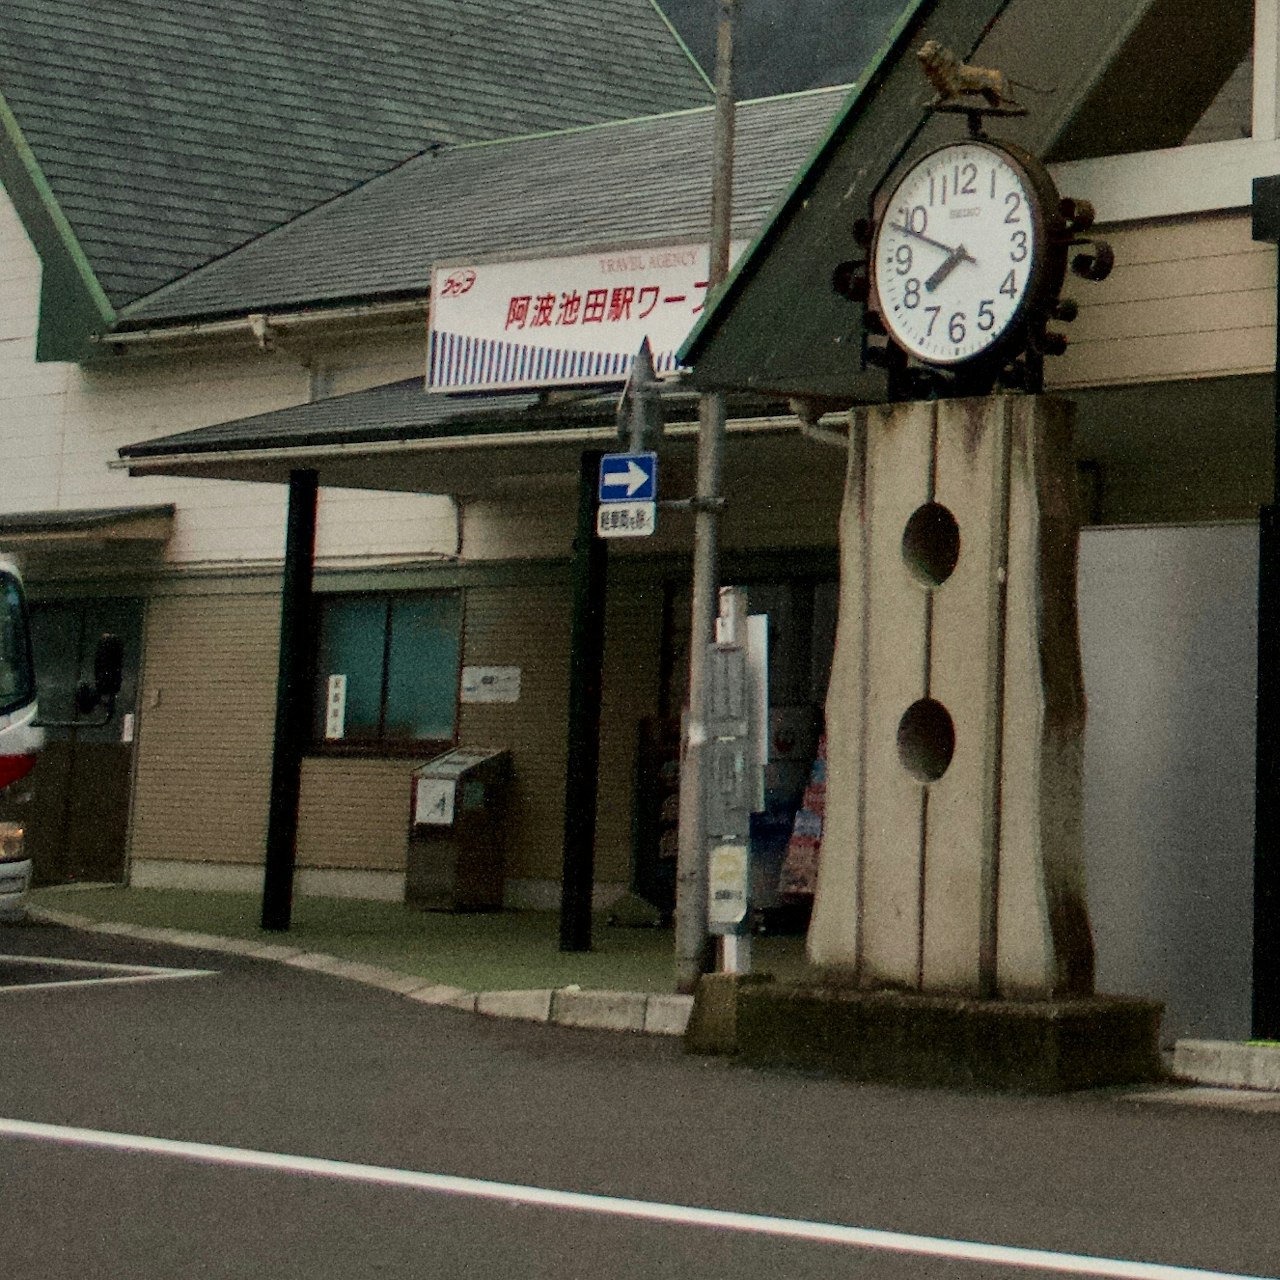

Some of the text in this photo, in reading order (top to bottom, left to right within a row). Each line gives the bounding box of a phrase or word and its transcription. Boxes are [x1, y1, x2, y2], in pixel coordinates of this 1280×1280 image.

[929, 170, 947, 205] 11
[953, 162, 978, 195] 12
[989, 169, 997, 200] 1
[904, 205, 928, 236] 10
[1004, 192, 1021, 224] 2
[895, 244, 913, 276] 9
[1010, 230, 1027, 263] 3
[903, 277, 921, 310] 8
[999, 269, 1018, 299] 4
[924, 305, 942, 336] 7
[949, 312, 966, 344] 6
[977, 299, 996, 332] 5
